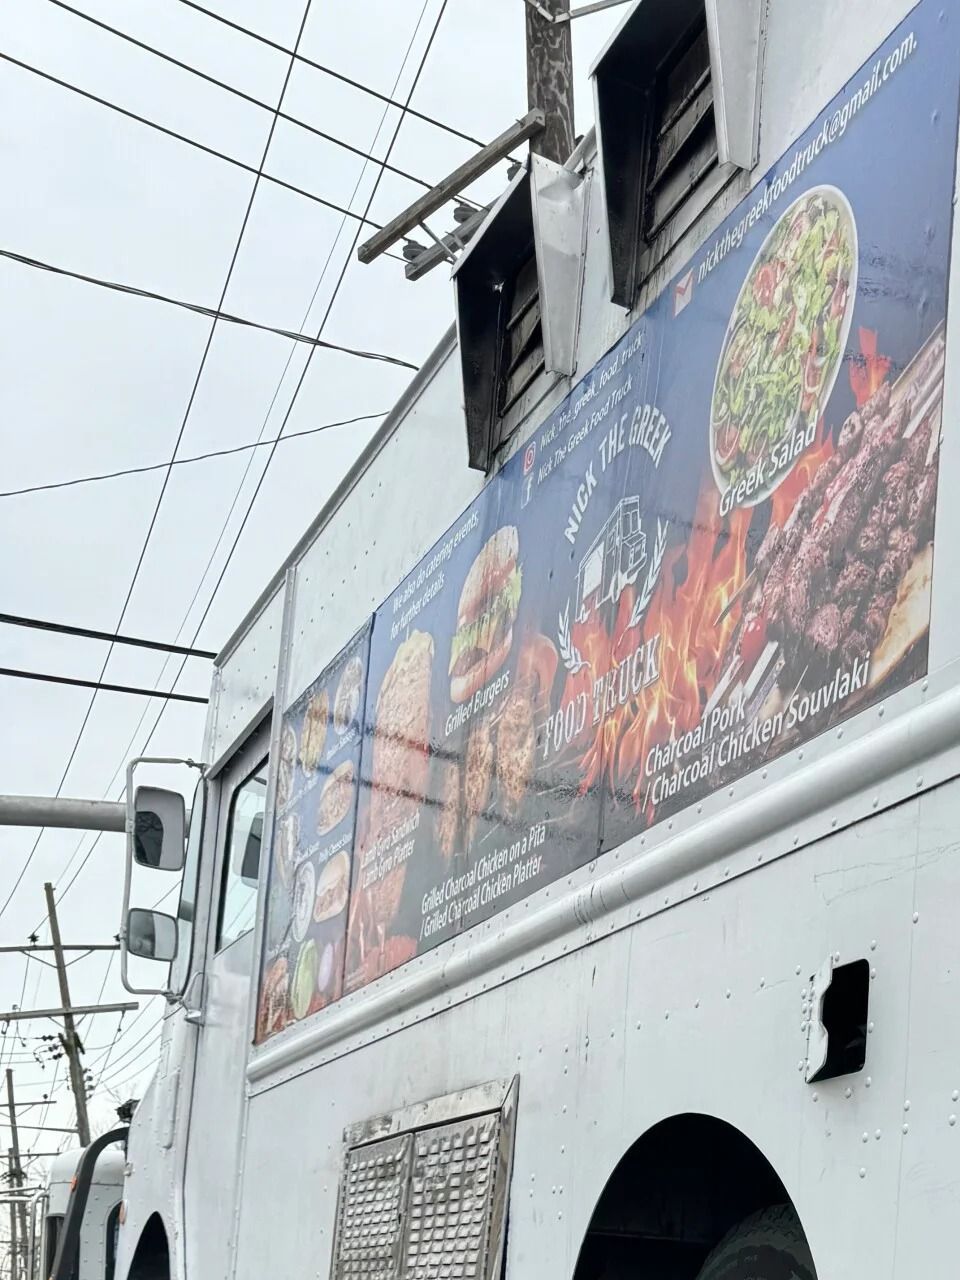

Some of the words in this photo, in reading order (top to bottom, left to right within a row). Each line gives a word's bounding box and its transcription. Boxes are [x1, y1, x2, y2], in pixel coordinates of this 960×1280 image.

[538, 454, 552, 485] Nick
[554, 445, 567, 469] The
[567, 417, 590, 453] Greek
[590, 397, 610, 432] Food
[611, 373, 633, 410] Truck
[720, 457, 767, 517] Greek
[768, 409, 819, 478] Salad
[564, 460, 598, 545] NICK
[599, 412, 629, 473] THE
[628, 404, 672, 470] GREEK
[403, 579, 416, 603] also
[416, 567, 427, 589] do
[425, 540, 454, 579] catering
[422, 570, 445, 608] details
[445, 695, 474, 737] Grilled
[473, 670, 511, 714] Burgers
[543, 691, 588, 761] FOOD
[592, 632, 661, 728] TRUCK
[645, 715, 708, 777] Charcoal
[709, 694, 748, 739] Pork
[716, 709, 783, 767] Chicken
[785, 651, 872, 729] Souvlaki
[361, 848, 377, 869] Lamb
[376, 832, 391, 857] Gyro
[390, 808, 421, 847] Sandwich
[362, 864, 379, 889] Lamb
[377, 857, 393, 881] Gyro
[393, 837, 416, 868] Platter
[421, 880, 446, 915] Grilled
[445, 861, 477, 900] Charcoal
[477, 846, 508, 881] Chicken
[509, 843, 520, 862] on
[521, 837, 527, 855] a
[528, 824, 546, 852] Pita
[447, 884, 480, 925] Charcoal
[480, 871, 512, 906] Chicken
[512, 855, 543, 888] Platter
